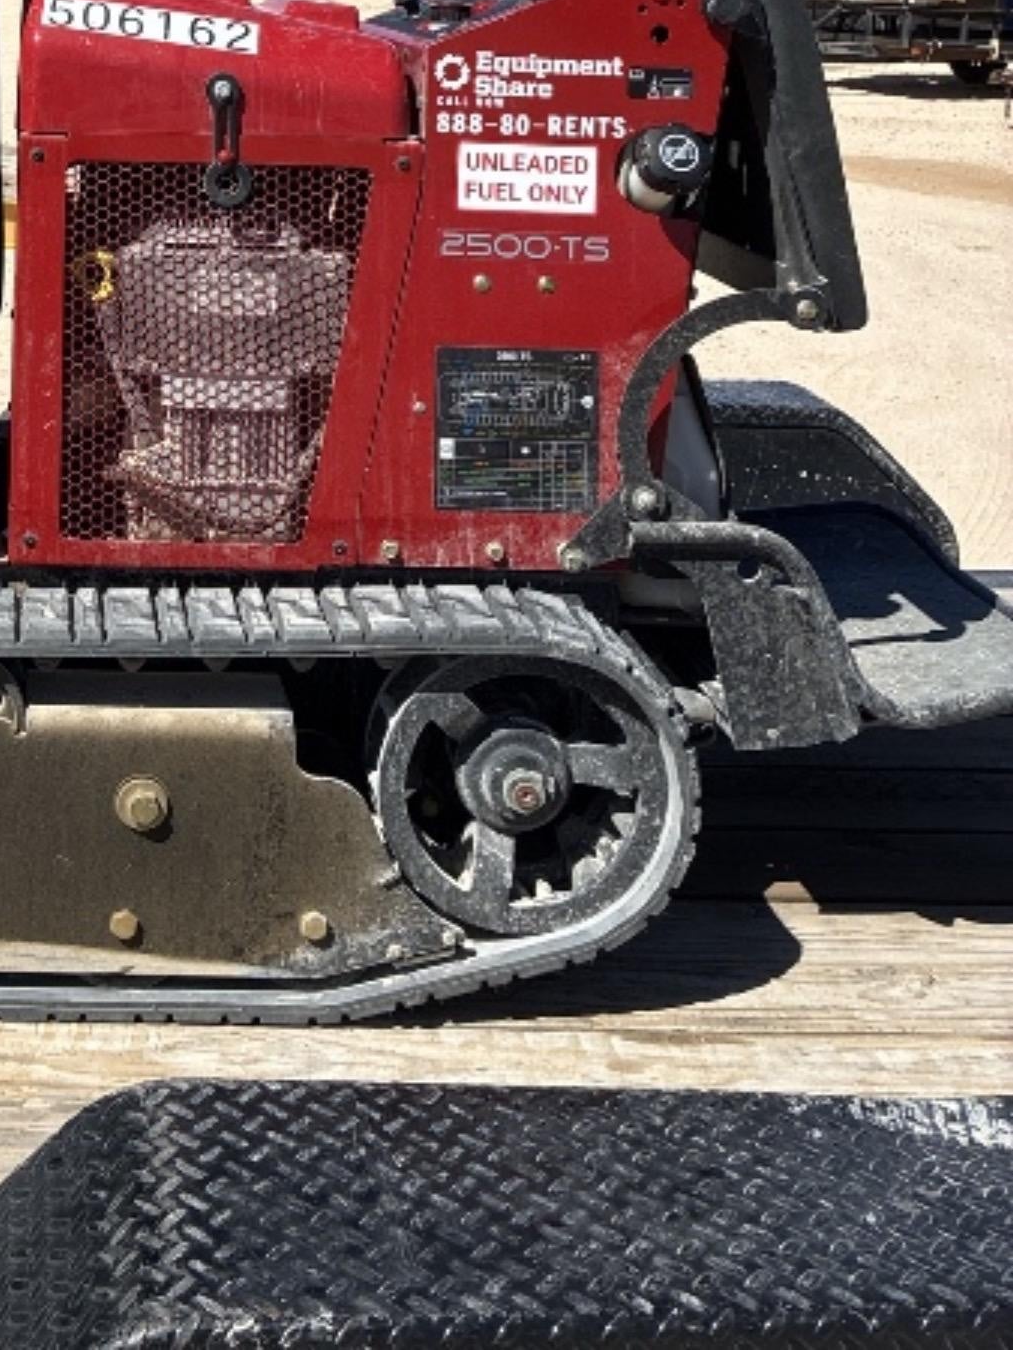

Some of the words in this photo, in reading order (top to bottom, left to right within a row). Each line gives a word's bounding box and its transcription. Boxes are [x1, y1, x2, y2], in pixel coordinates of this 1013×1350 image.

[475, 50, 624, 78] Equipment
[474, 75, 554, 98] Share
[466, 152, 589, 176] UNLEADED
[464, 181, 522, 202] FUEL
[528, 183, 589, 205] ONLY
